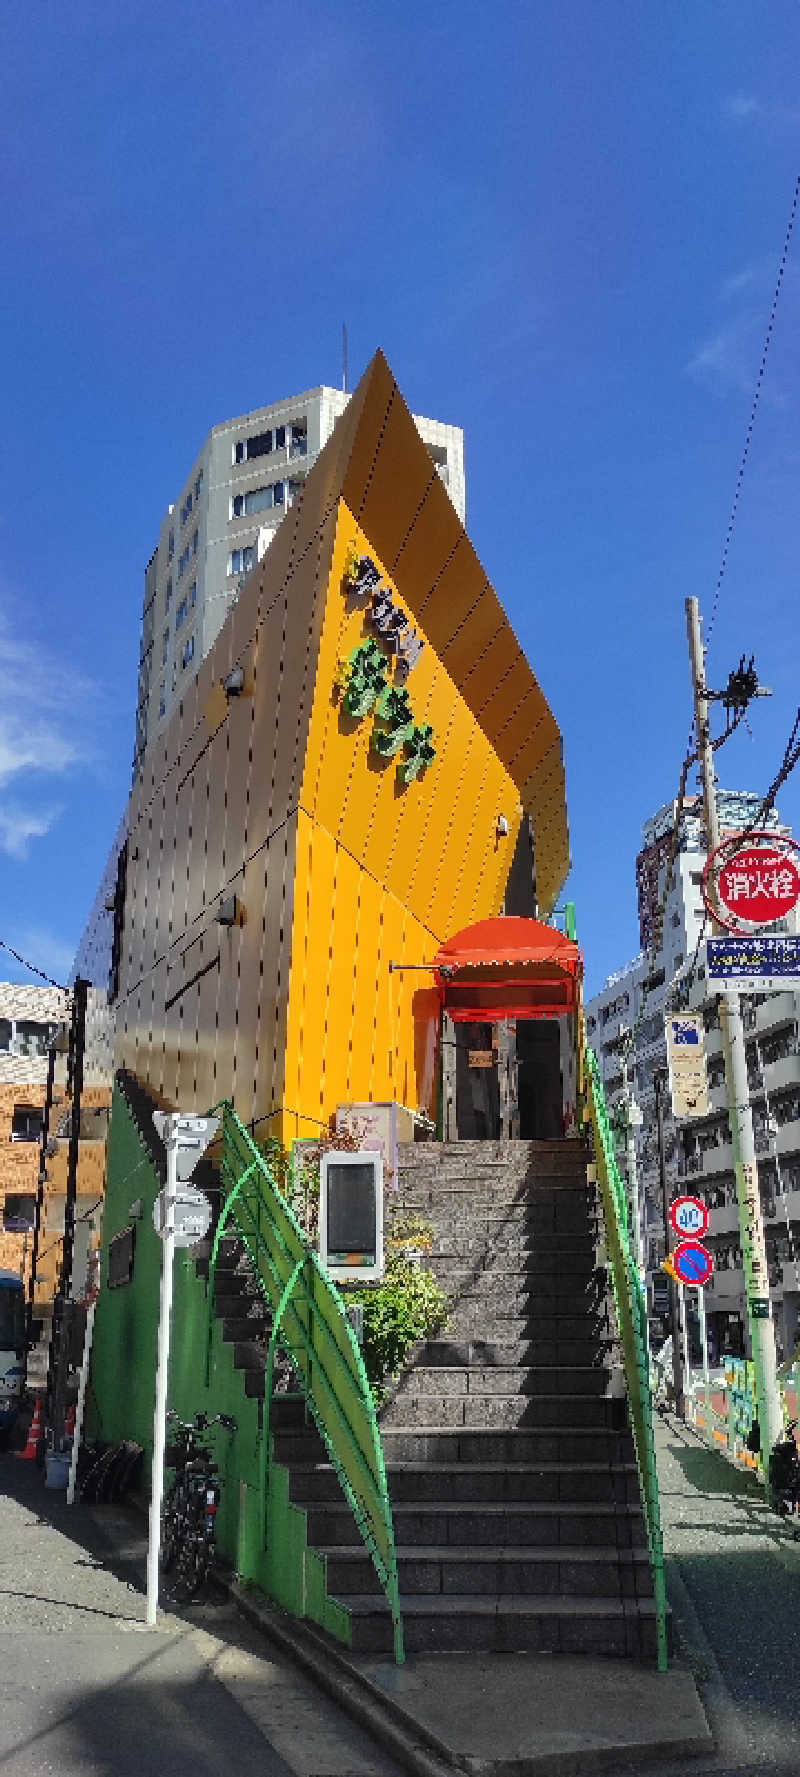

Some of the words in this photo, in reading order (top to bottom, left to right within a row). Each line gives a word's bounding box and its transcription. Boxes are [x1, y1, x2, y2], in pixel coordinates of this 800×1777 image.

[725, 869, 794, 900] 消火栓
[680, 1208, 698, 1227] 40
